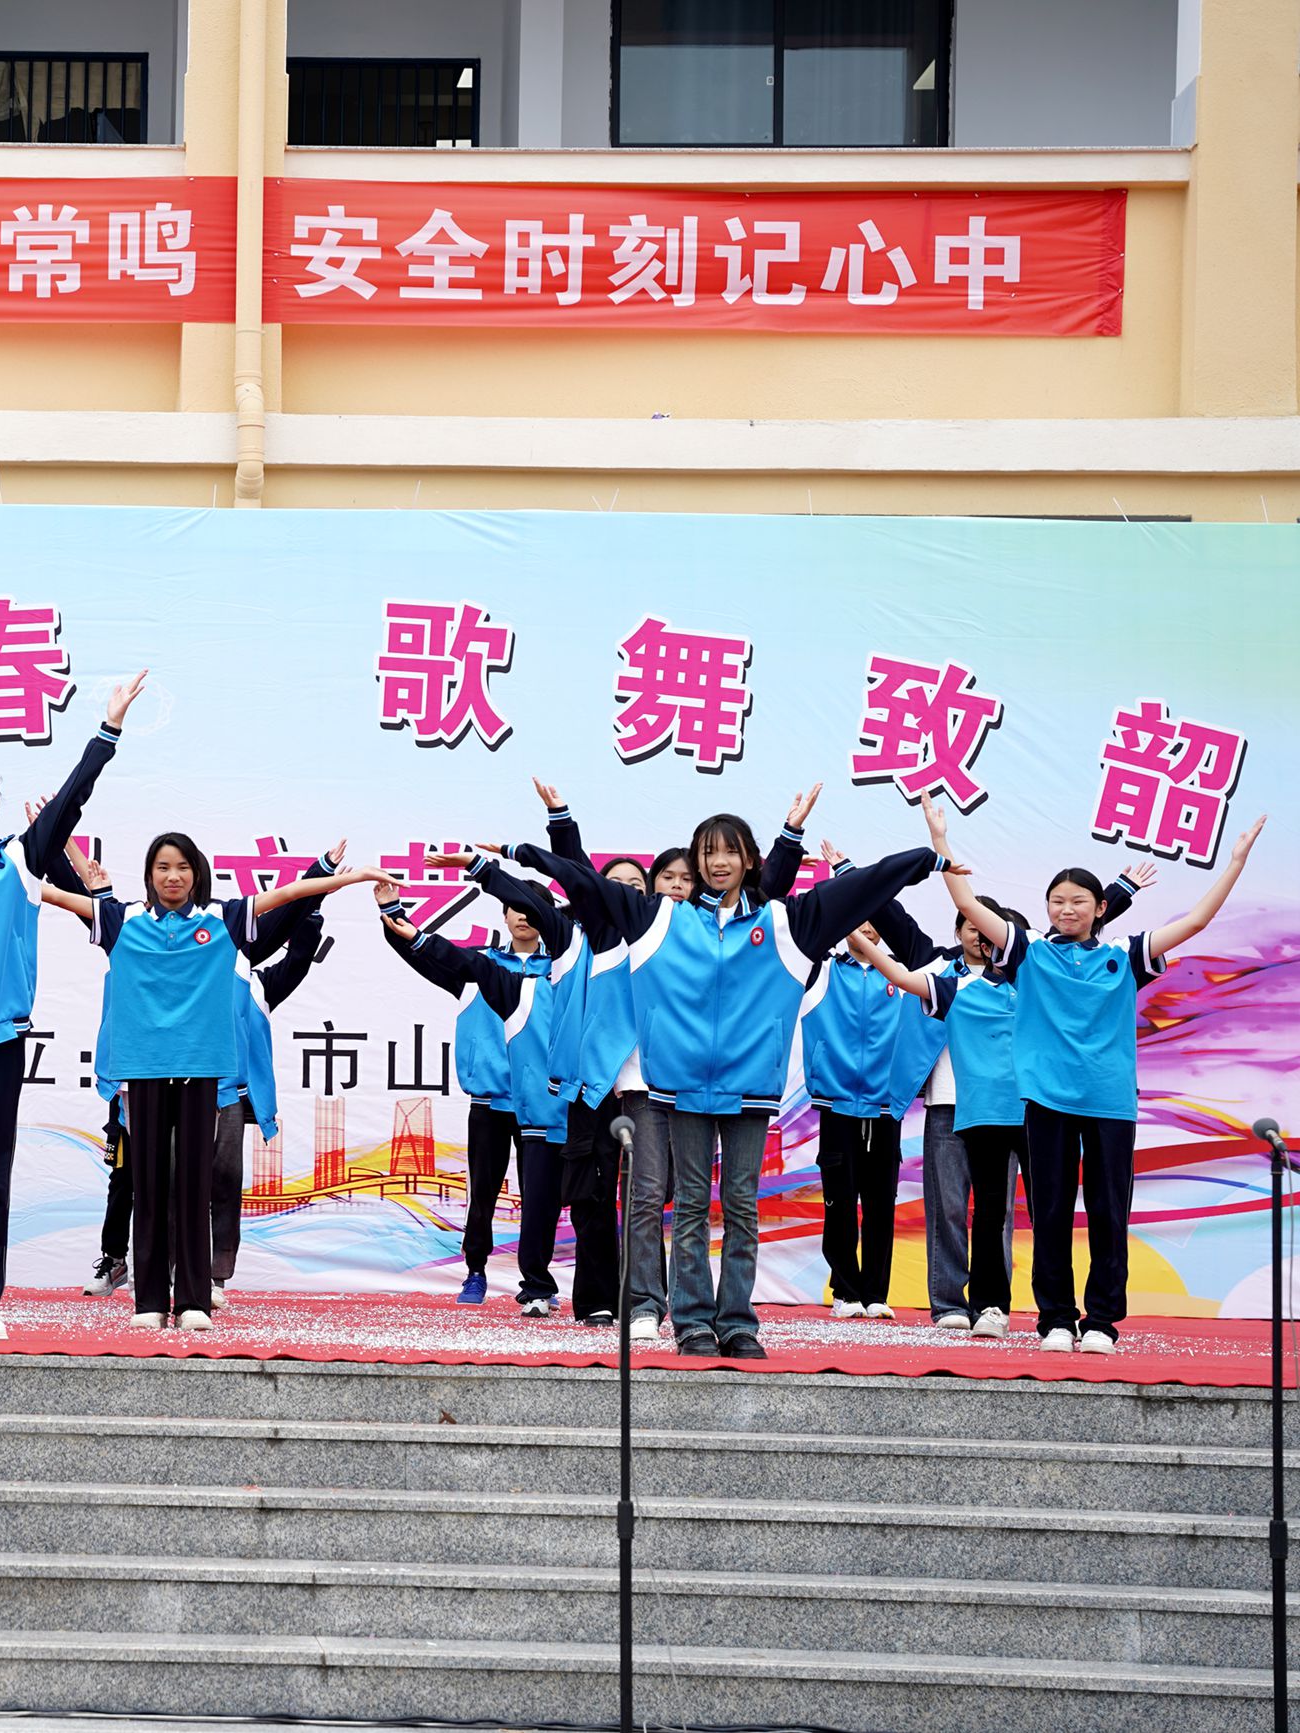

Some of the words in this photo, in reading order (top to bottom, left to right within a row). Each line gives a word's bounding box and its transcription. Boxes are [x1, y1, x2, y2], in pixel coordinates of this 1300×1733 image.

[289, 204, 1022, 310] 安全时刻记心中
[375, 596, 1246, 867] 歌舞致韶
